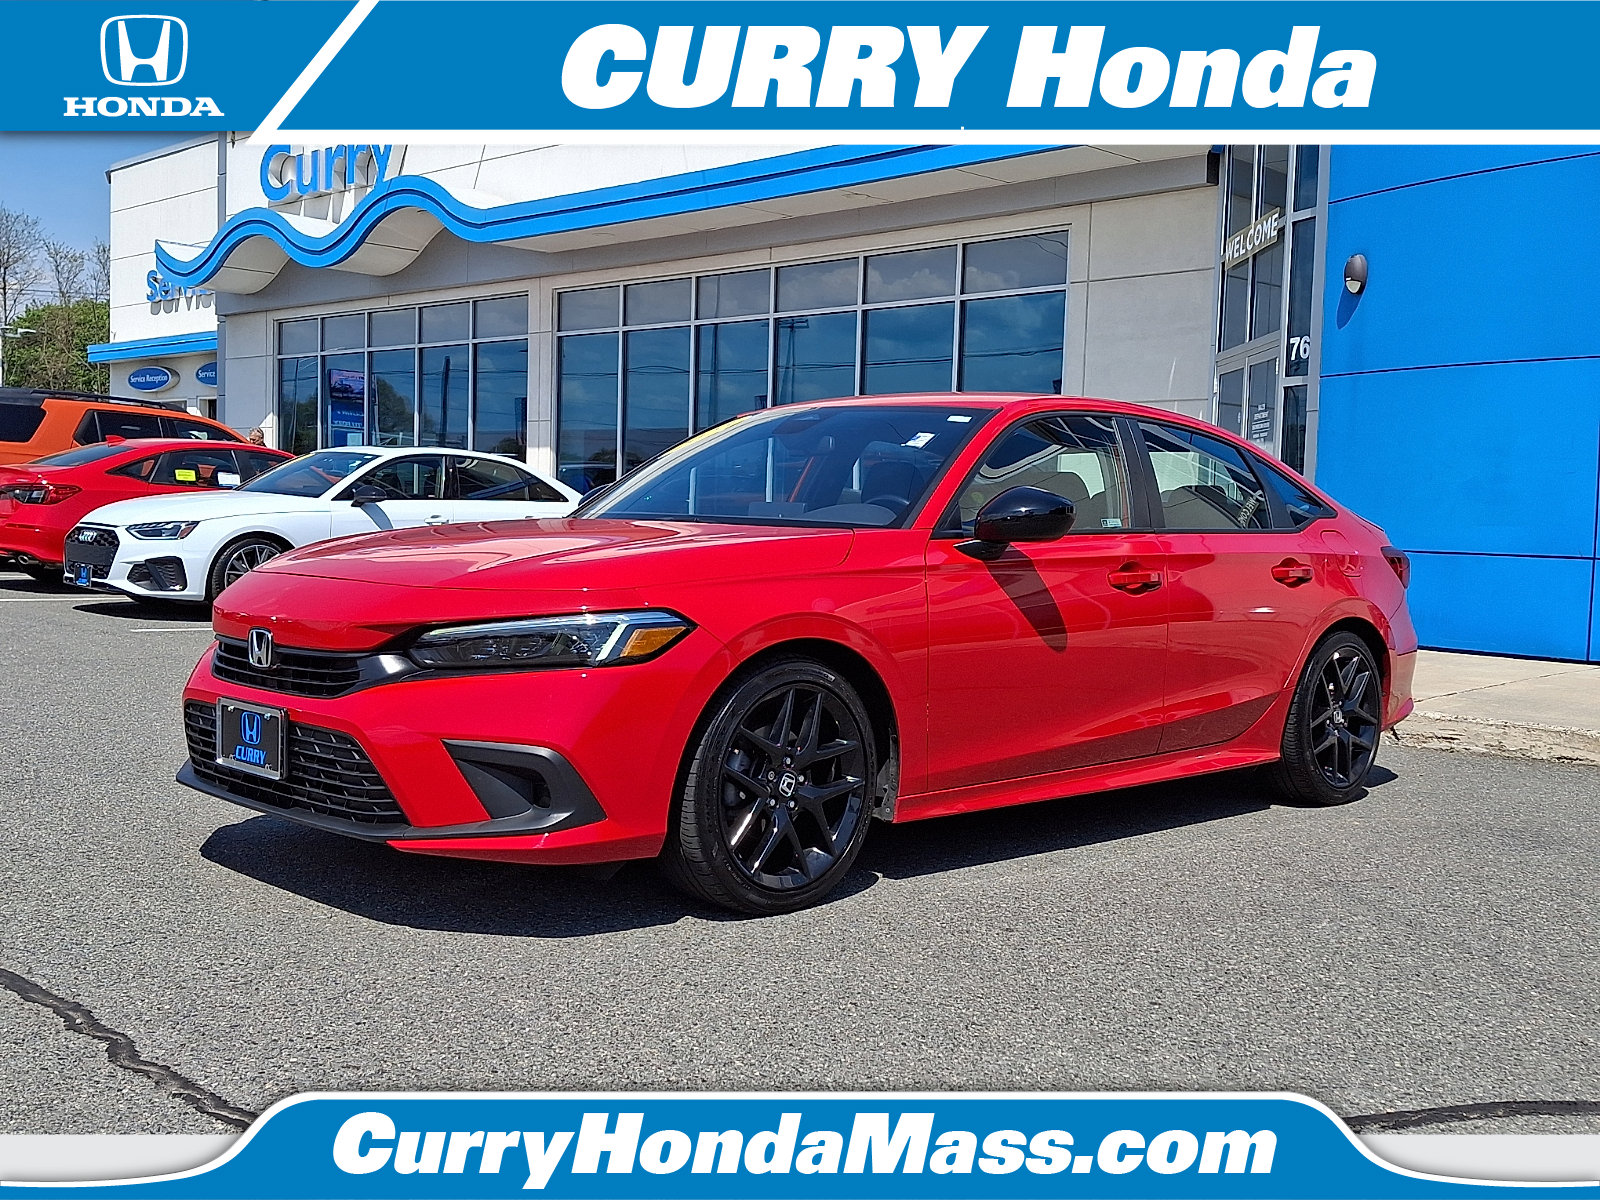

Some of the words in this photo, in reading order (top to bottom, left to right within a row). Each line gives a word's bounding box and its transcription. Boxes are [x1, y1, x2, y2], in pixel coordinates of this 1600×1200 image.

[260, 144, 393, 202] Curry
[1225, 212, 1279, 263] WELCOME
[1289, 335, 1311, 361] 76
[130, 375, 146, 383] Service
[146, 374, 168, 383] Reception
[198, 370, 216, 378] Service
[235, 745, 267, 765] CURRY
